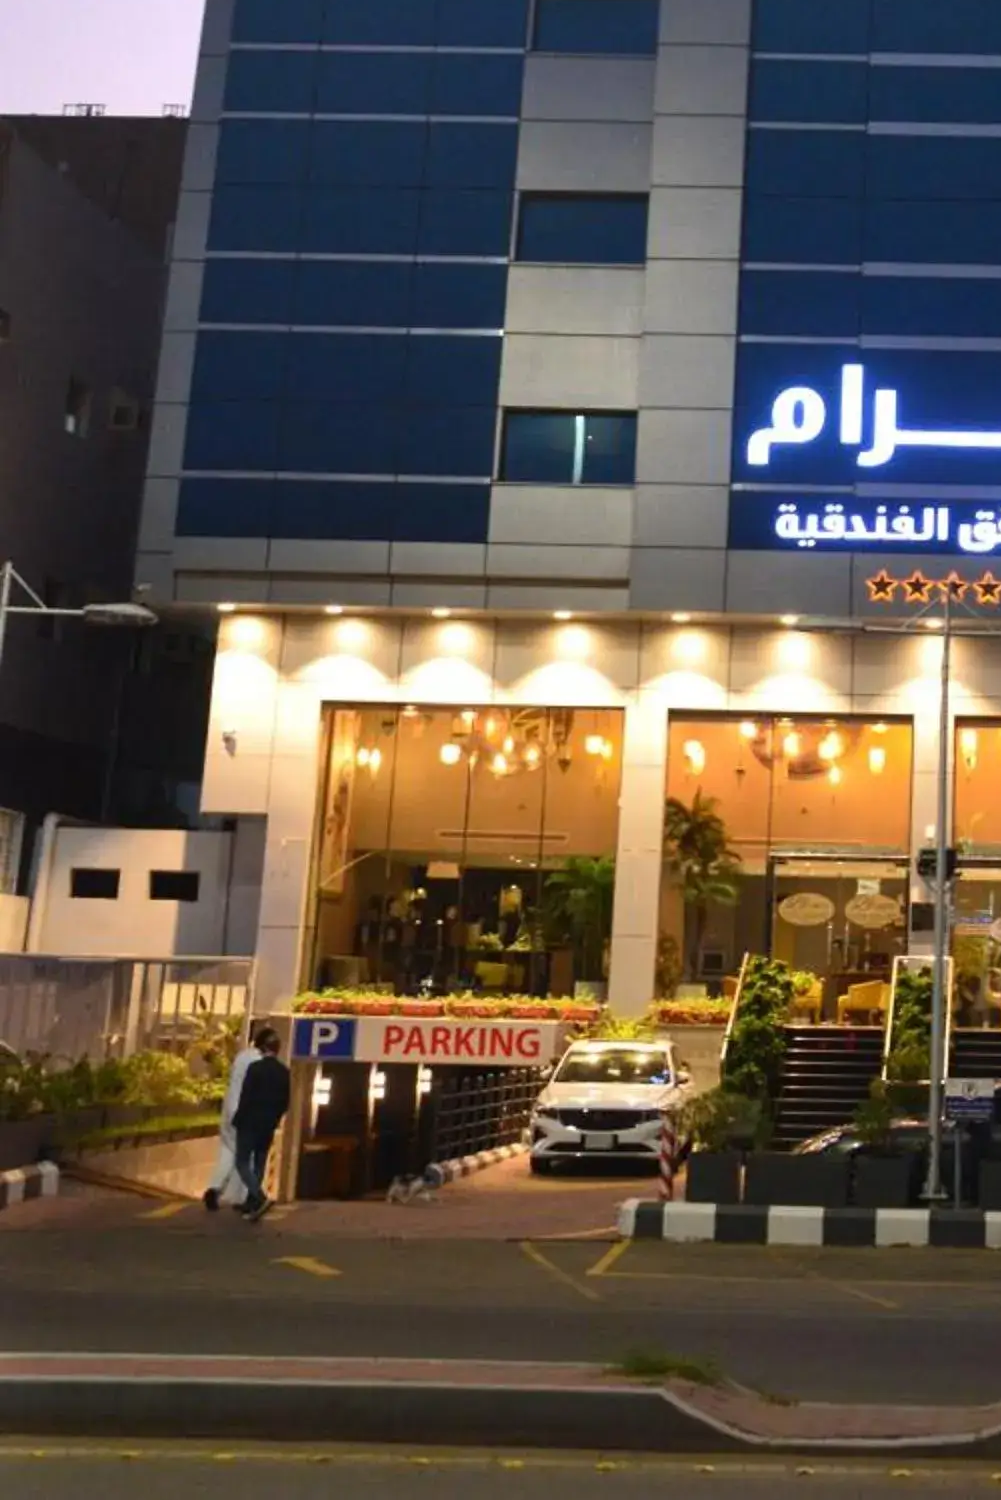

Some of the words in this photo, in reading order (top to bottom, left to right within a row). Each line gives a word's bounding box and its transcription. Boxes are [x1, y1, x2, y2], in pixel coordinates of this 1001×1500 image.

[774, 503, 950, 547] الفندقية
[310, 1022, 339, 1056] P
[382, 1025, 541, 1058] PARKING
